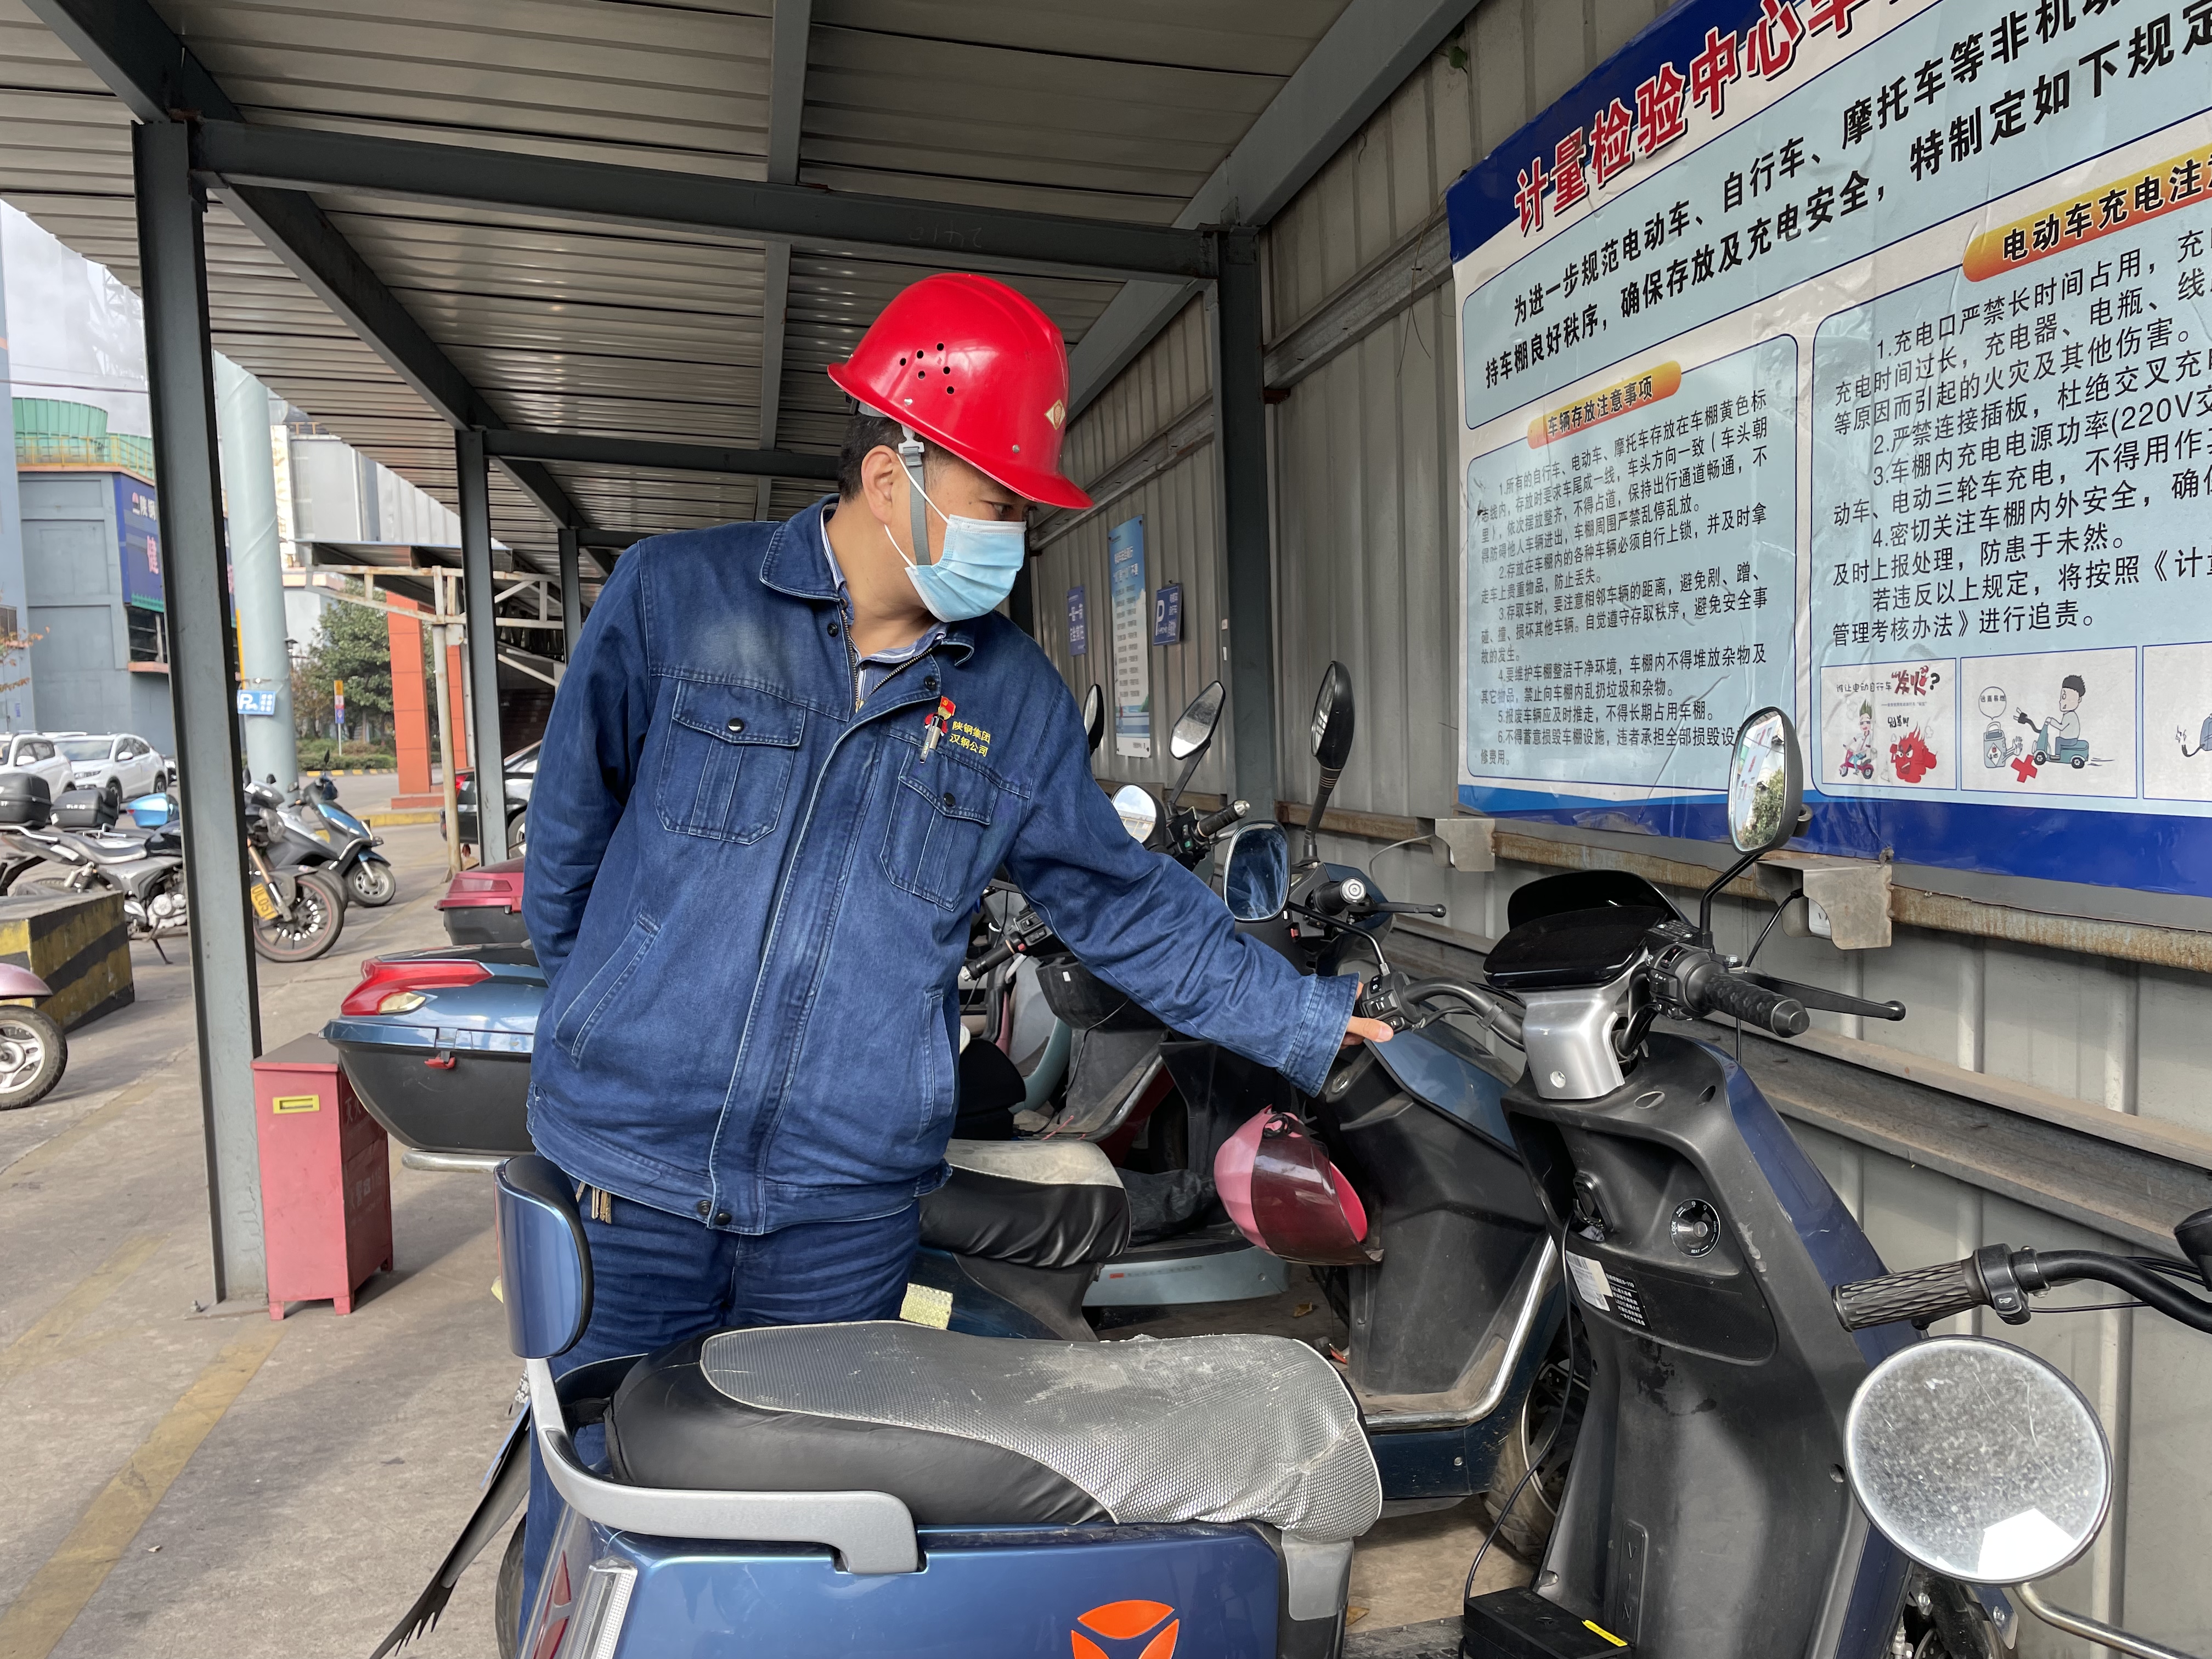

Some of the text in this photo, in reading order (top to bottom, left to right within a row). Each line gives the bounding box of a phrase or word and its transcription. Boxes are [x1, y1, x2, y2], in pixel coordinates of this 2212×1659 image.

[2004, 154, 2212, 261] 电动车充电注
[1877, 227, 2212, 360] 1.充电口严禁长时间占用，充
[1835, 268, 2212, 407] 充电时间过长，充电器、电瓶、线
[1548, 375, 1653, 437] 车辆存放注意事项
[1834, 318, 2188, 437] 等原因而引起的火灾及其他伤害。
[1874, 348, 2212, 455] 2.严禁连接插板，杜绝交叉充
[1833, 427, 2212, 528] 动车、电动三轮车充电，不得用作
[1481, 567, 1600, 605] 走车上贵重物品，防止丢失。
[1833, 523, 2123, 589] 及时上报处理，防患于未然。
[1872, 545, 2212, 613] 若违反以上规定，将按照《计
[1155, 600, 1165, 636] P
[1833, 599, 2094, 648] 管理考核办法》进行追责。
[1481, 645, 1519, 664] 故的发生。
[239, 693, 253, 710] P
[952, 721, 991, 744] 陕钢集团
[949, 733, 989, 757] 汉钢公司
[1498, 726, 1740, 747] 6.不得蓄意损毁车棚设施，违者承担全部损毁设
